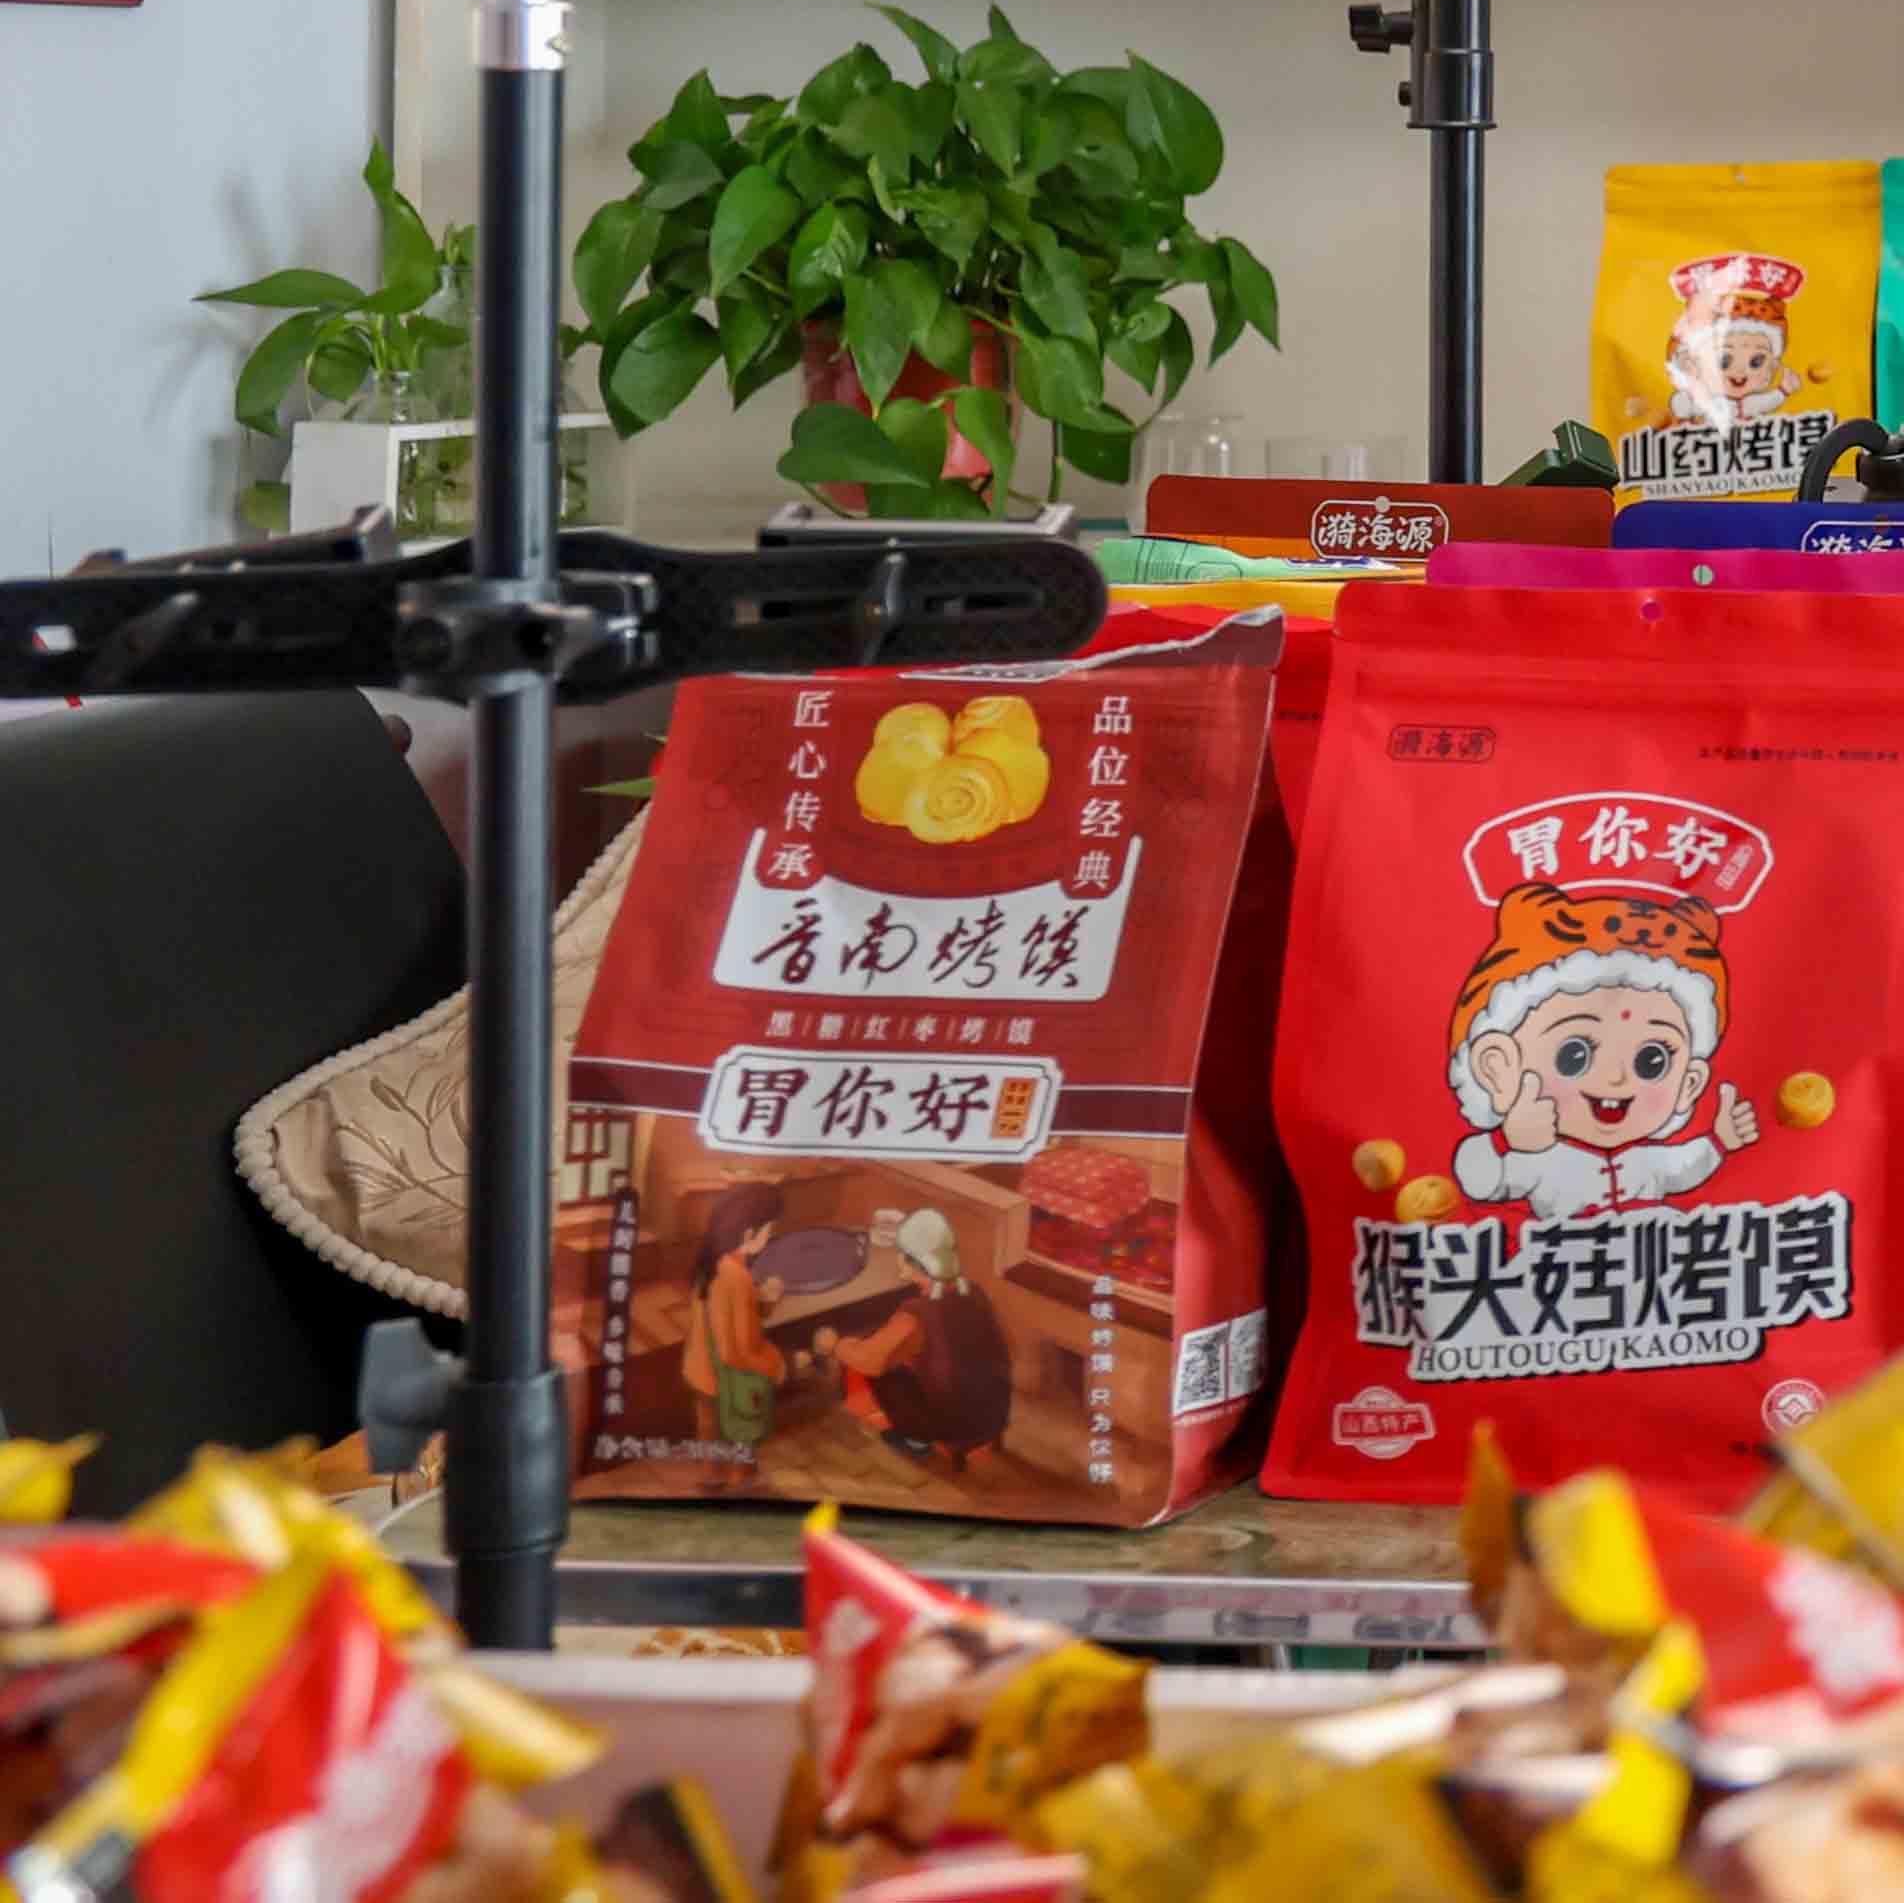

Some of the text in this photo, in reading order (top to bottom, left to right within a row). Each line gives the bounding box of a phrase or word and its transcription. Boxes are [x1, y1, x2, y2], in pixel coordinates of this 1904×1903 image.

[1645, 479, 1729, 496] SHANYAO
[1319, 513, 1435, 552] 漪海源
[767, 691, 831, 880] 匠心传承
[1073, 696, 1132, 890] 品位经典
[1507, 807, 1728, 880] 胃你好
[751, 898, 1085, 990] 晋南烤馍
[736, 1065, 990, 1142] 胃你好
[1357, 1201, 1847, 1340] 猴头菇烤馍
[1416, 1326, 1752, 1375] HOUTOUGU KAOMO
